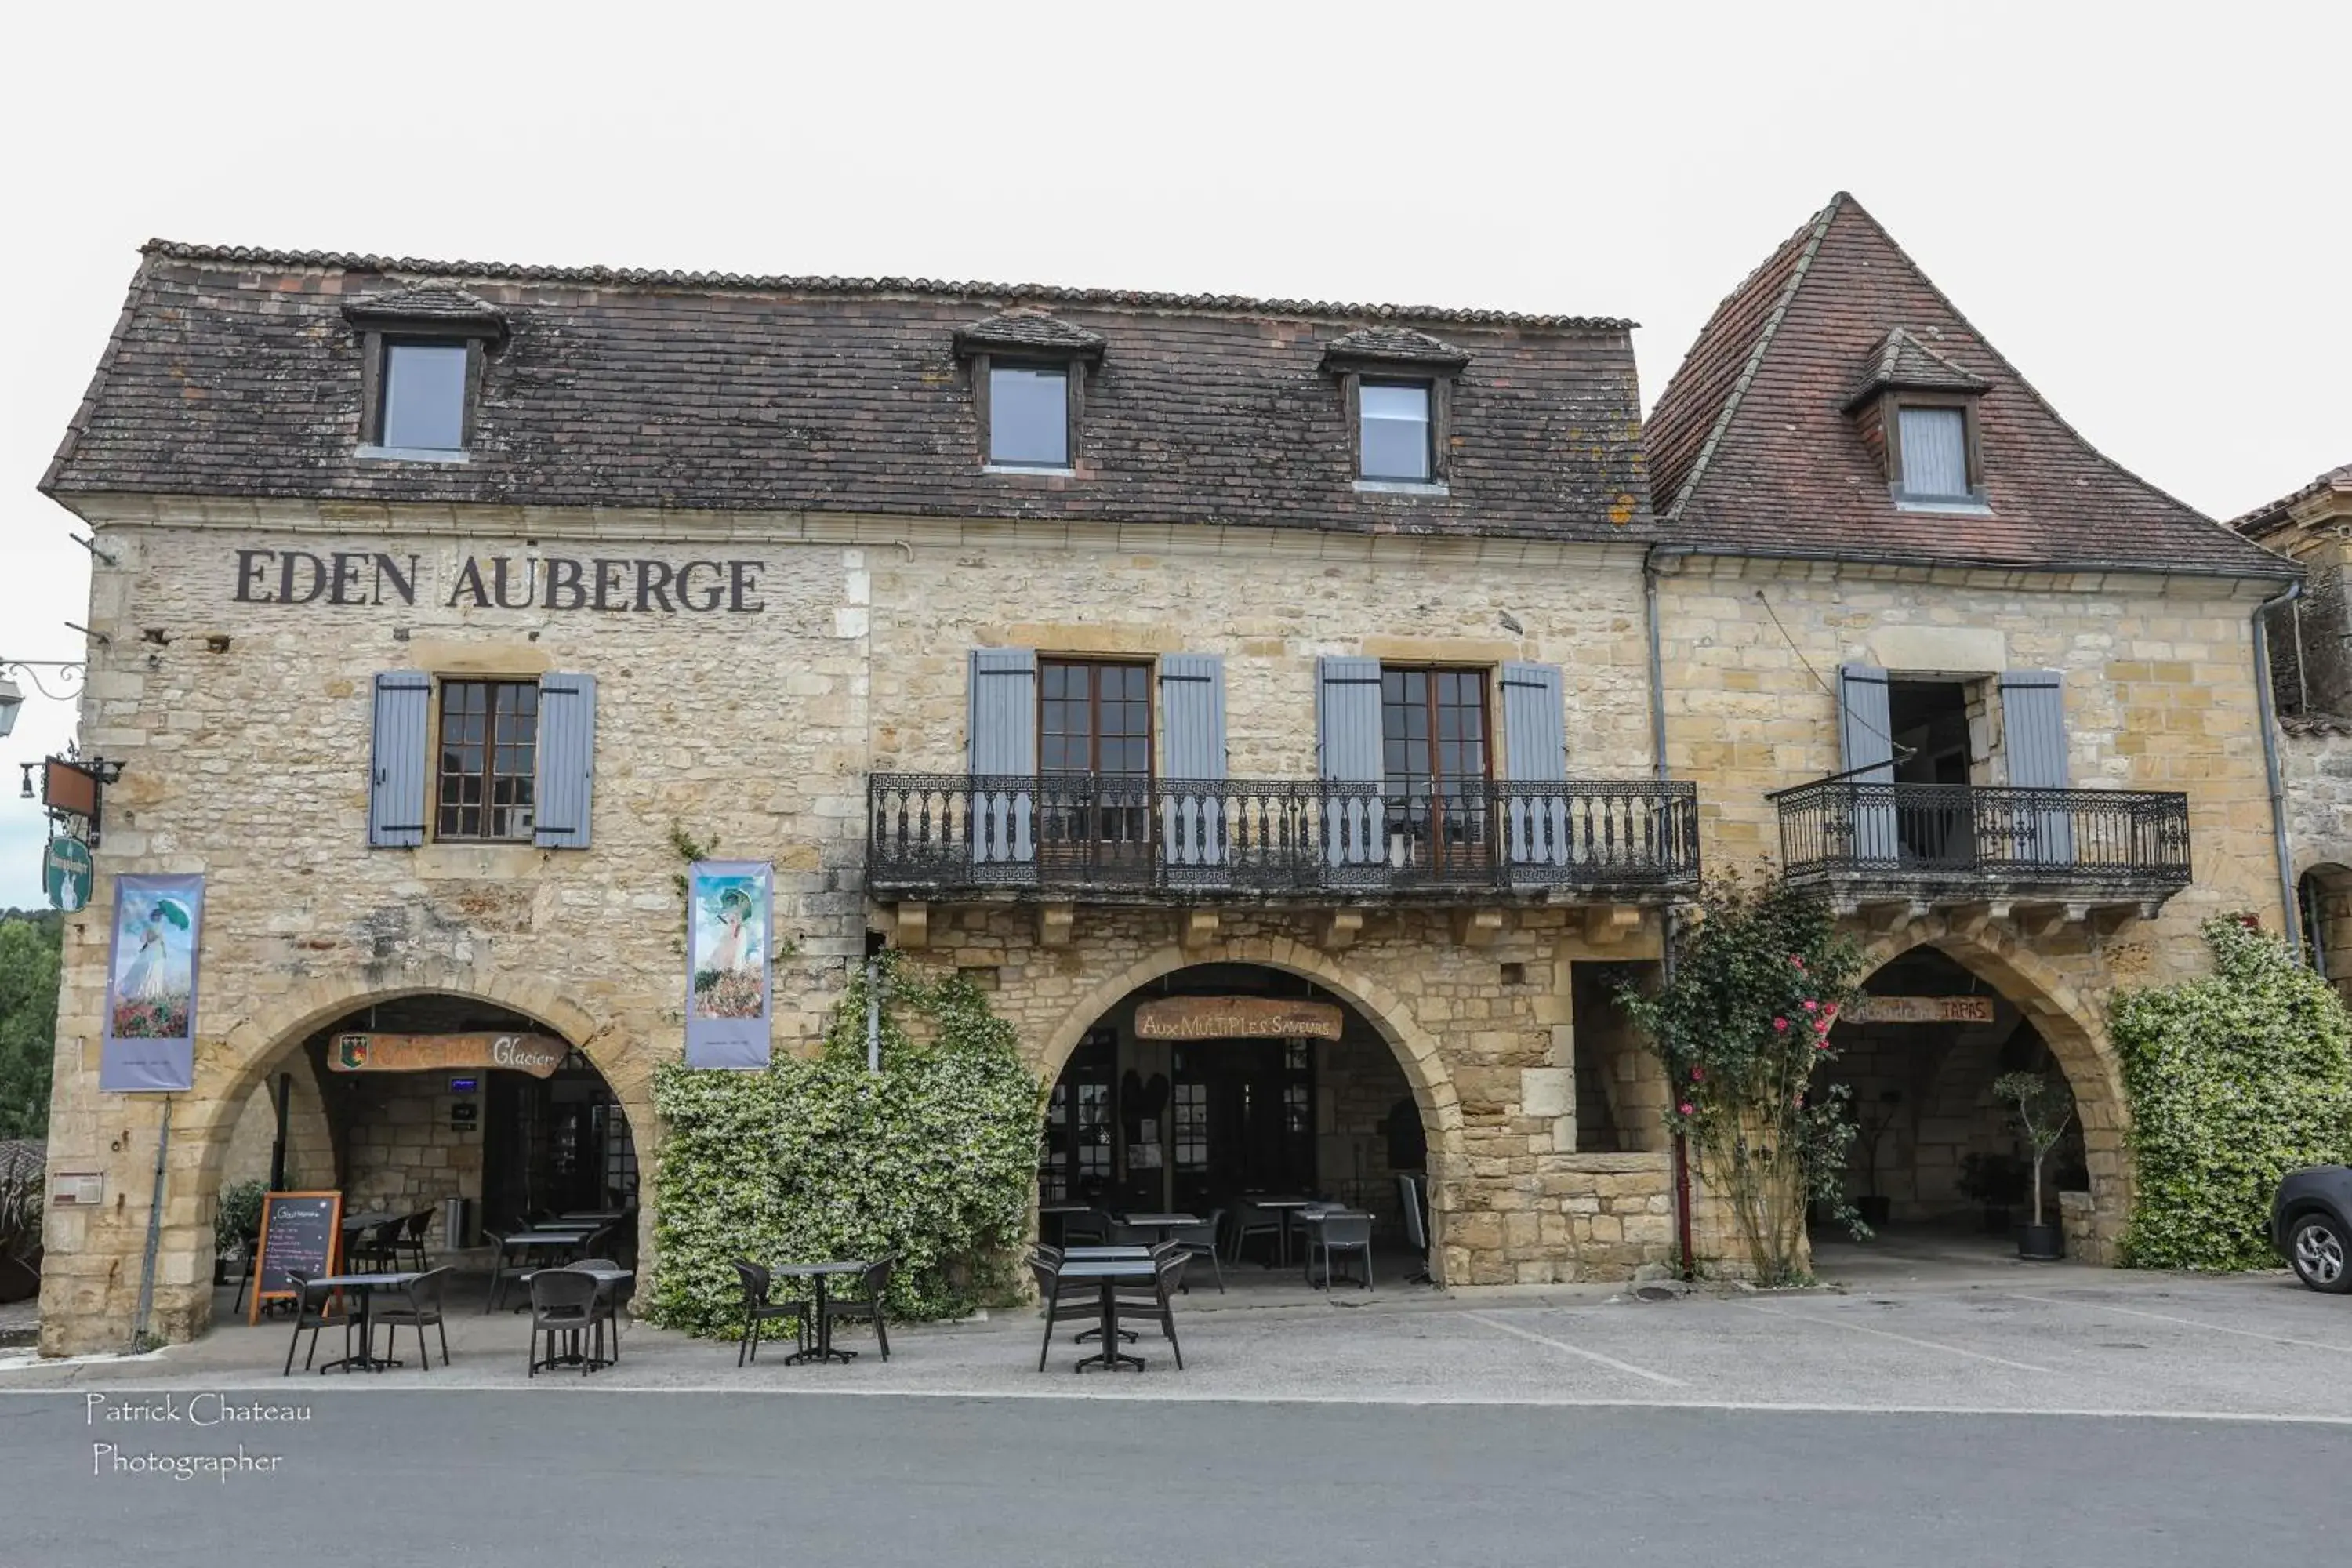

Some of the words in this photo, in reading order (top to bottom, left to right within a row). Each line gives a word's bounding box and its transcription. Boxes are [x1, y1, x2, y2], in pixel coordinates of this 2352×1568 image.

[233, 549, 421, 606] EDEN
[445, 555, 766, 612] AUBERGE
[1940, 1001, 1987, 1018] TAPAS
[493, 1036, 555, 1065] Glacier
